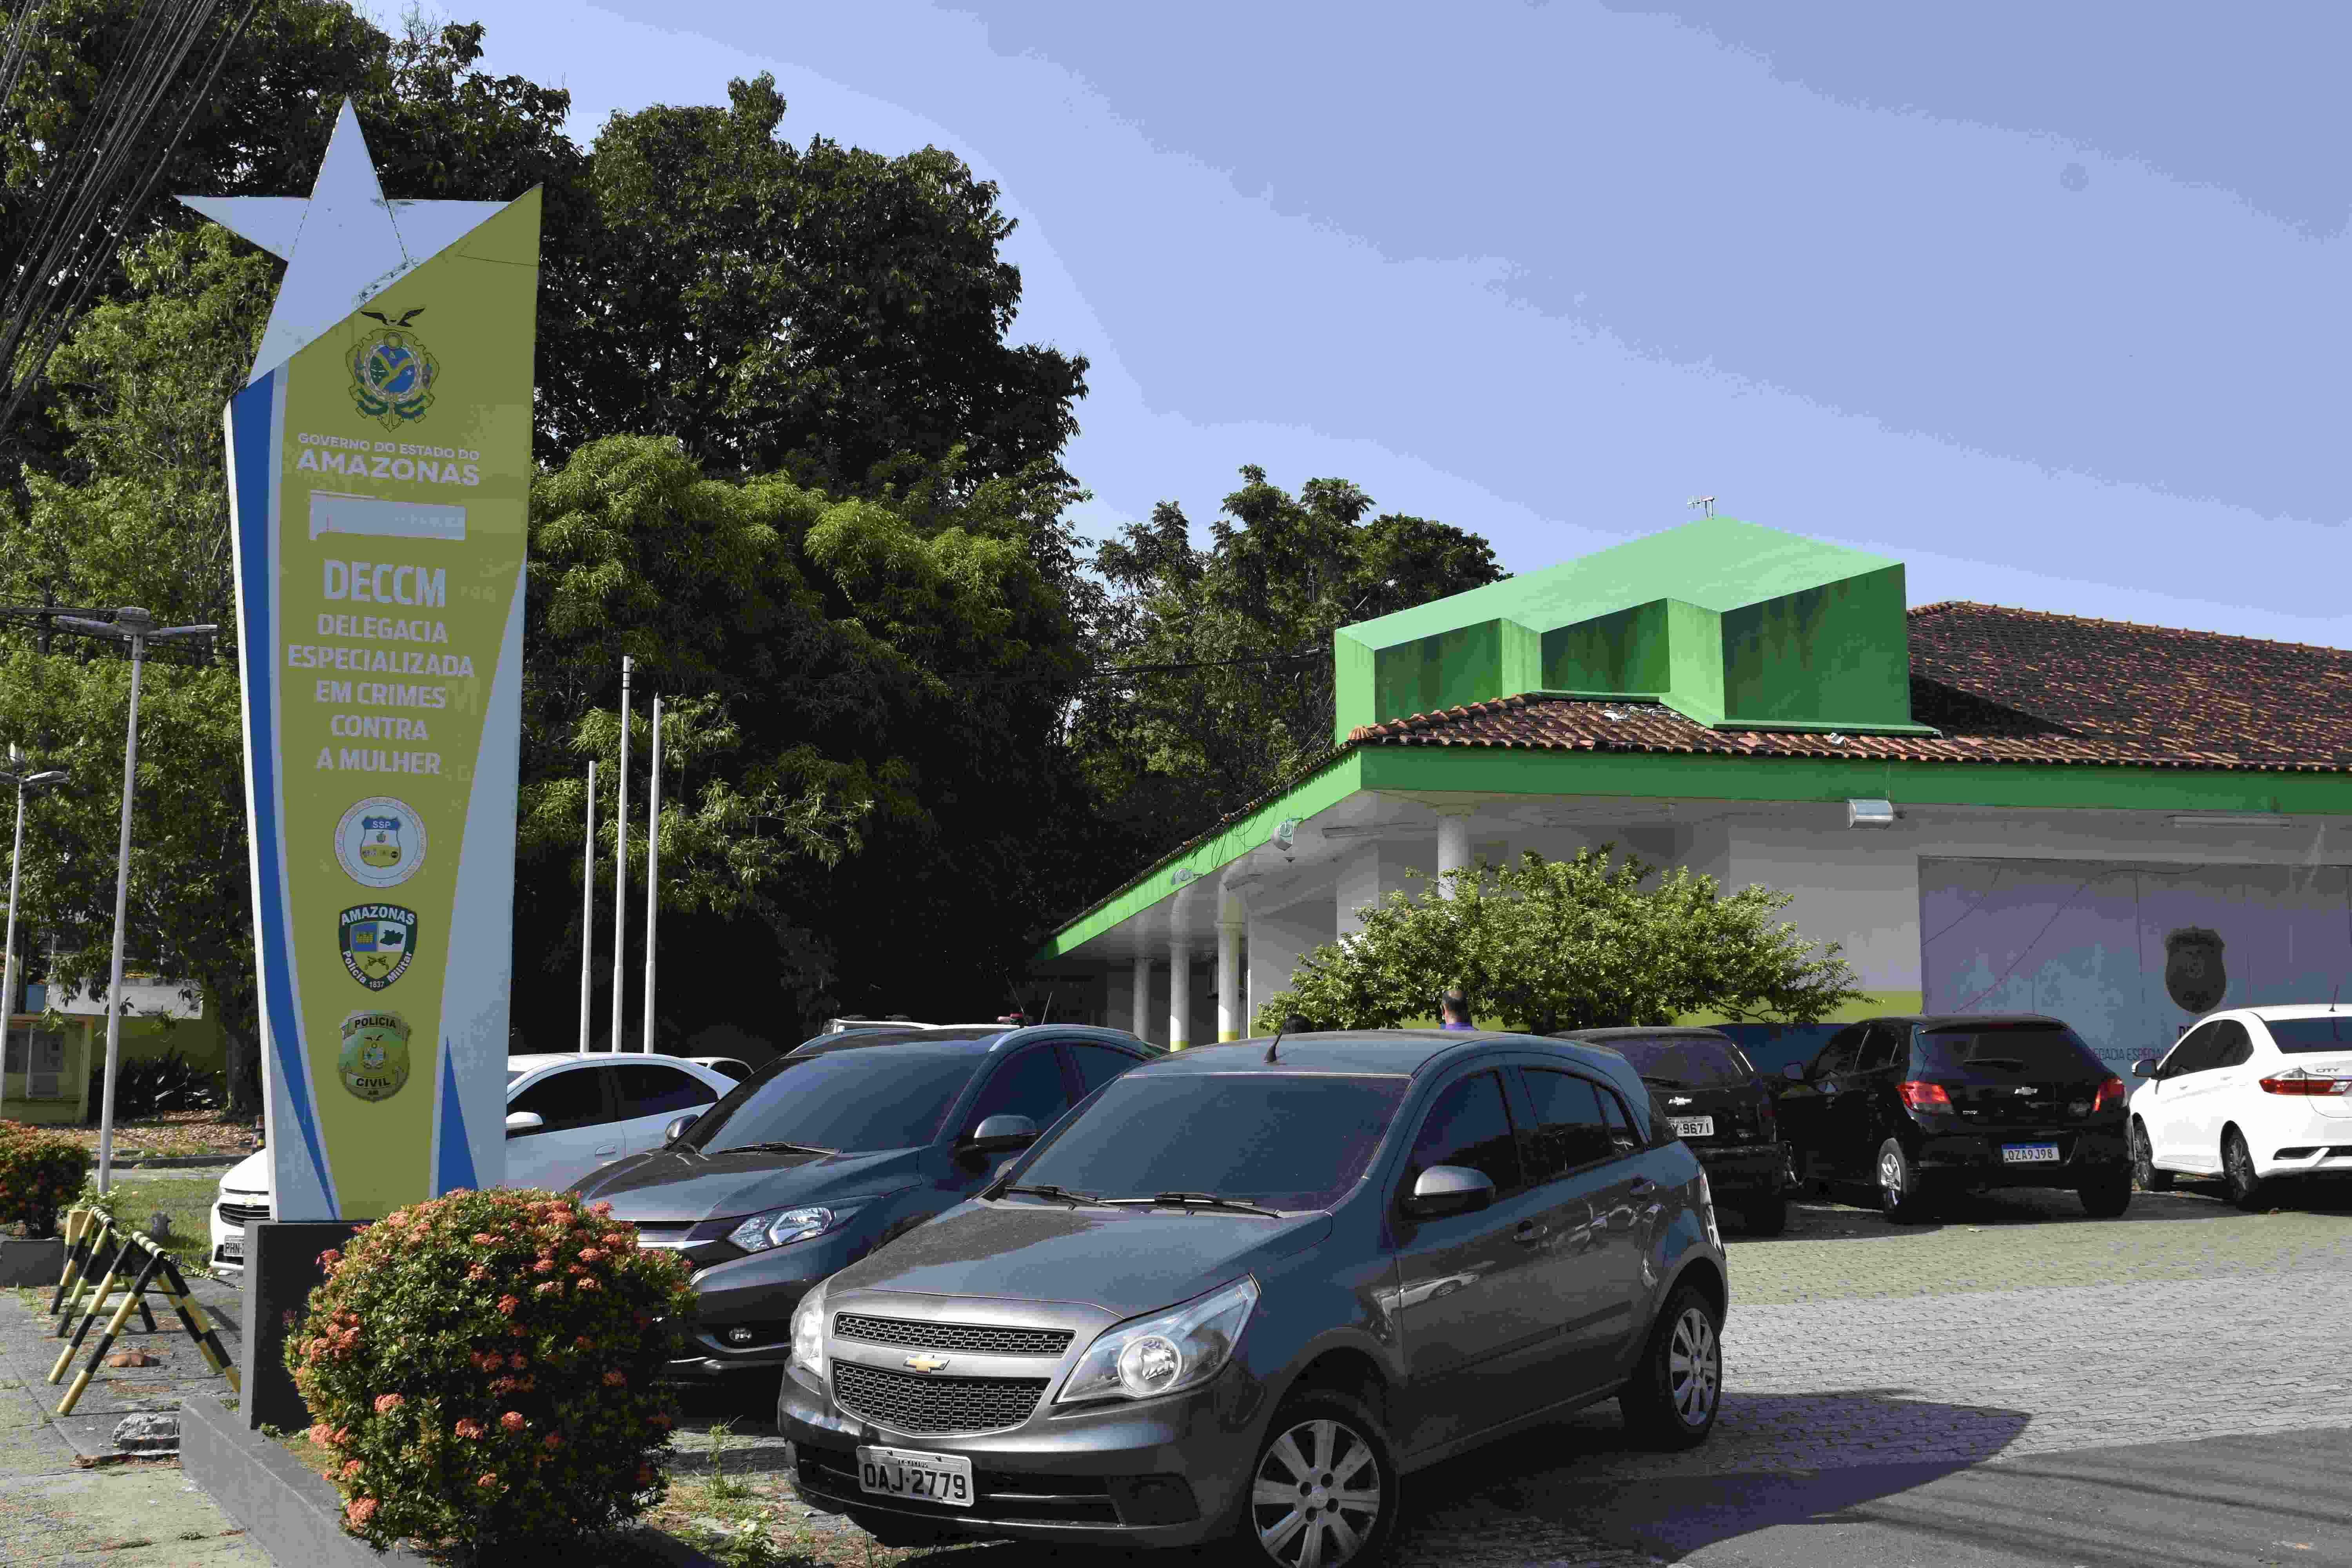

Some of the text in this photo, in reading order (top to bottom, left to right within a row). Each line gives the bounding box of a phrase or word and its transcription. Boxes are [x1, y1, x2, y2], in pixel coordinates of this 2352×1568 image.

[298, 433, 479, 460] GOVERNO DO ESTADO DO
[298, 449, 479, 486] AMAZONAS
[324, 559, 446, 608] DECCM
[318, 614, 448, 643] DELEGACIA
[289, 645, 474, 677] ESPECIALIZADA
[316, 681, 446, 708] EM CRIMES
[331, 715, 428, 740] CONTRA
[316, 747, 440, 774] A MULHER
[342, 906, 415, 925] AMAZONAS
[387, 951, 412, 982] Militar
[355, 1017, 396, 1028] POLICIA
[356, 1078, 391, 1087] CIVIL
